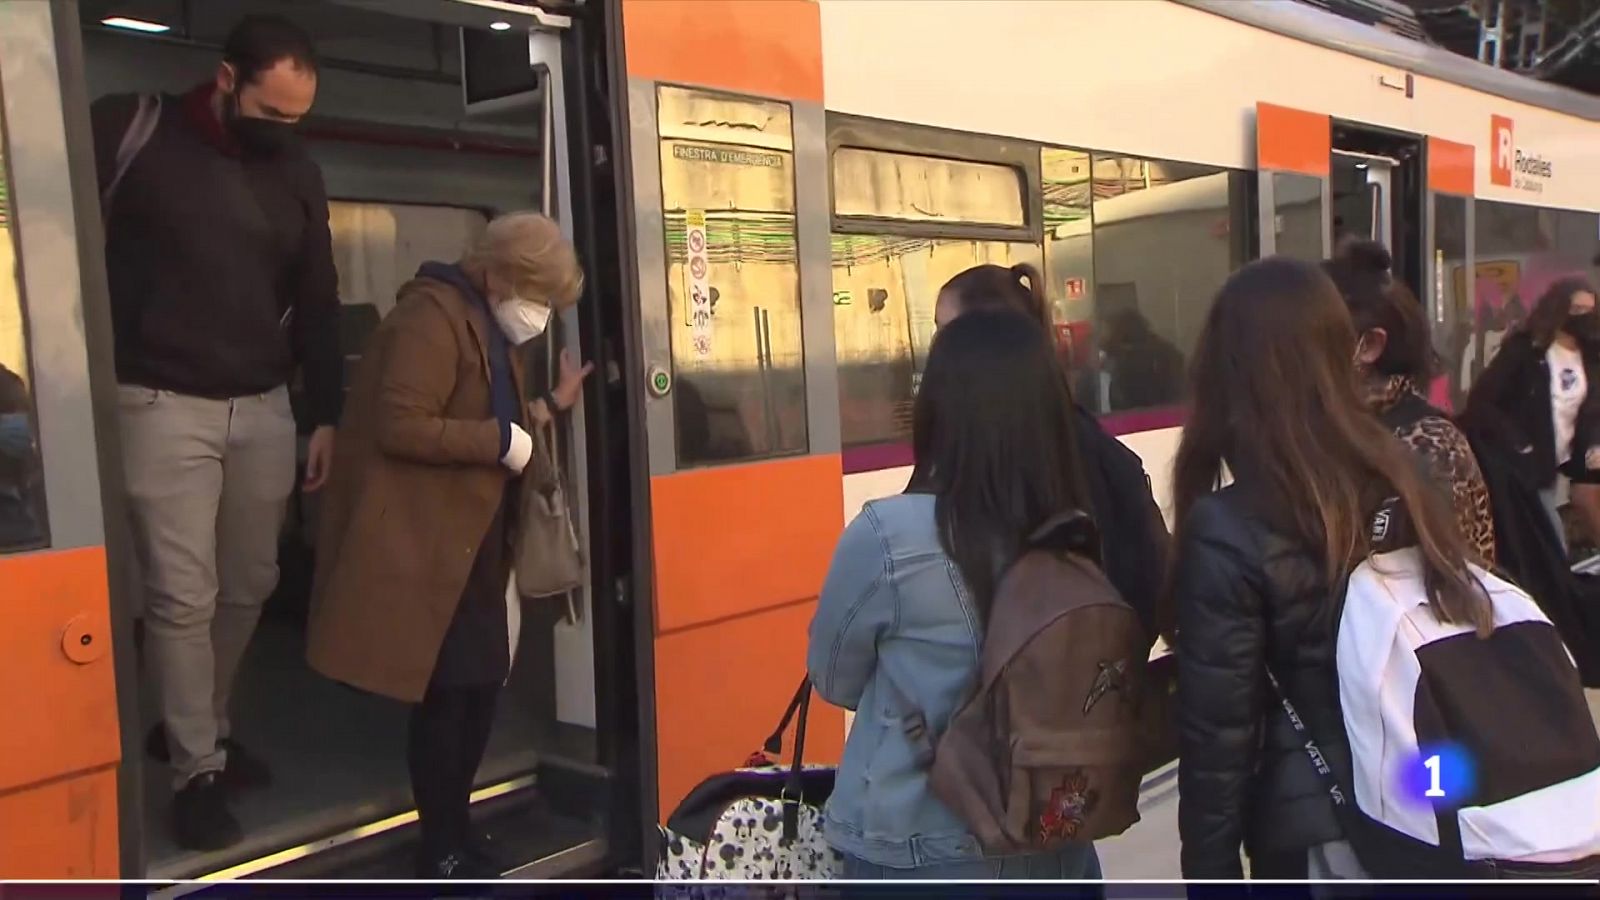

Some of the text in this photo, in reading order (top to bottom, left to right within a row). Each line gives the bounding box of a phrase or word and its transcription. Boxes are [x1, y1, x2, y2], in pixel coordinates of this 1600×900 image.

[674, 146, 718, 161] FINESTRA
[1305, 740, 1330, 774] VANS
[1330, 784, 1345, 805] VA
